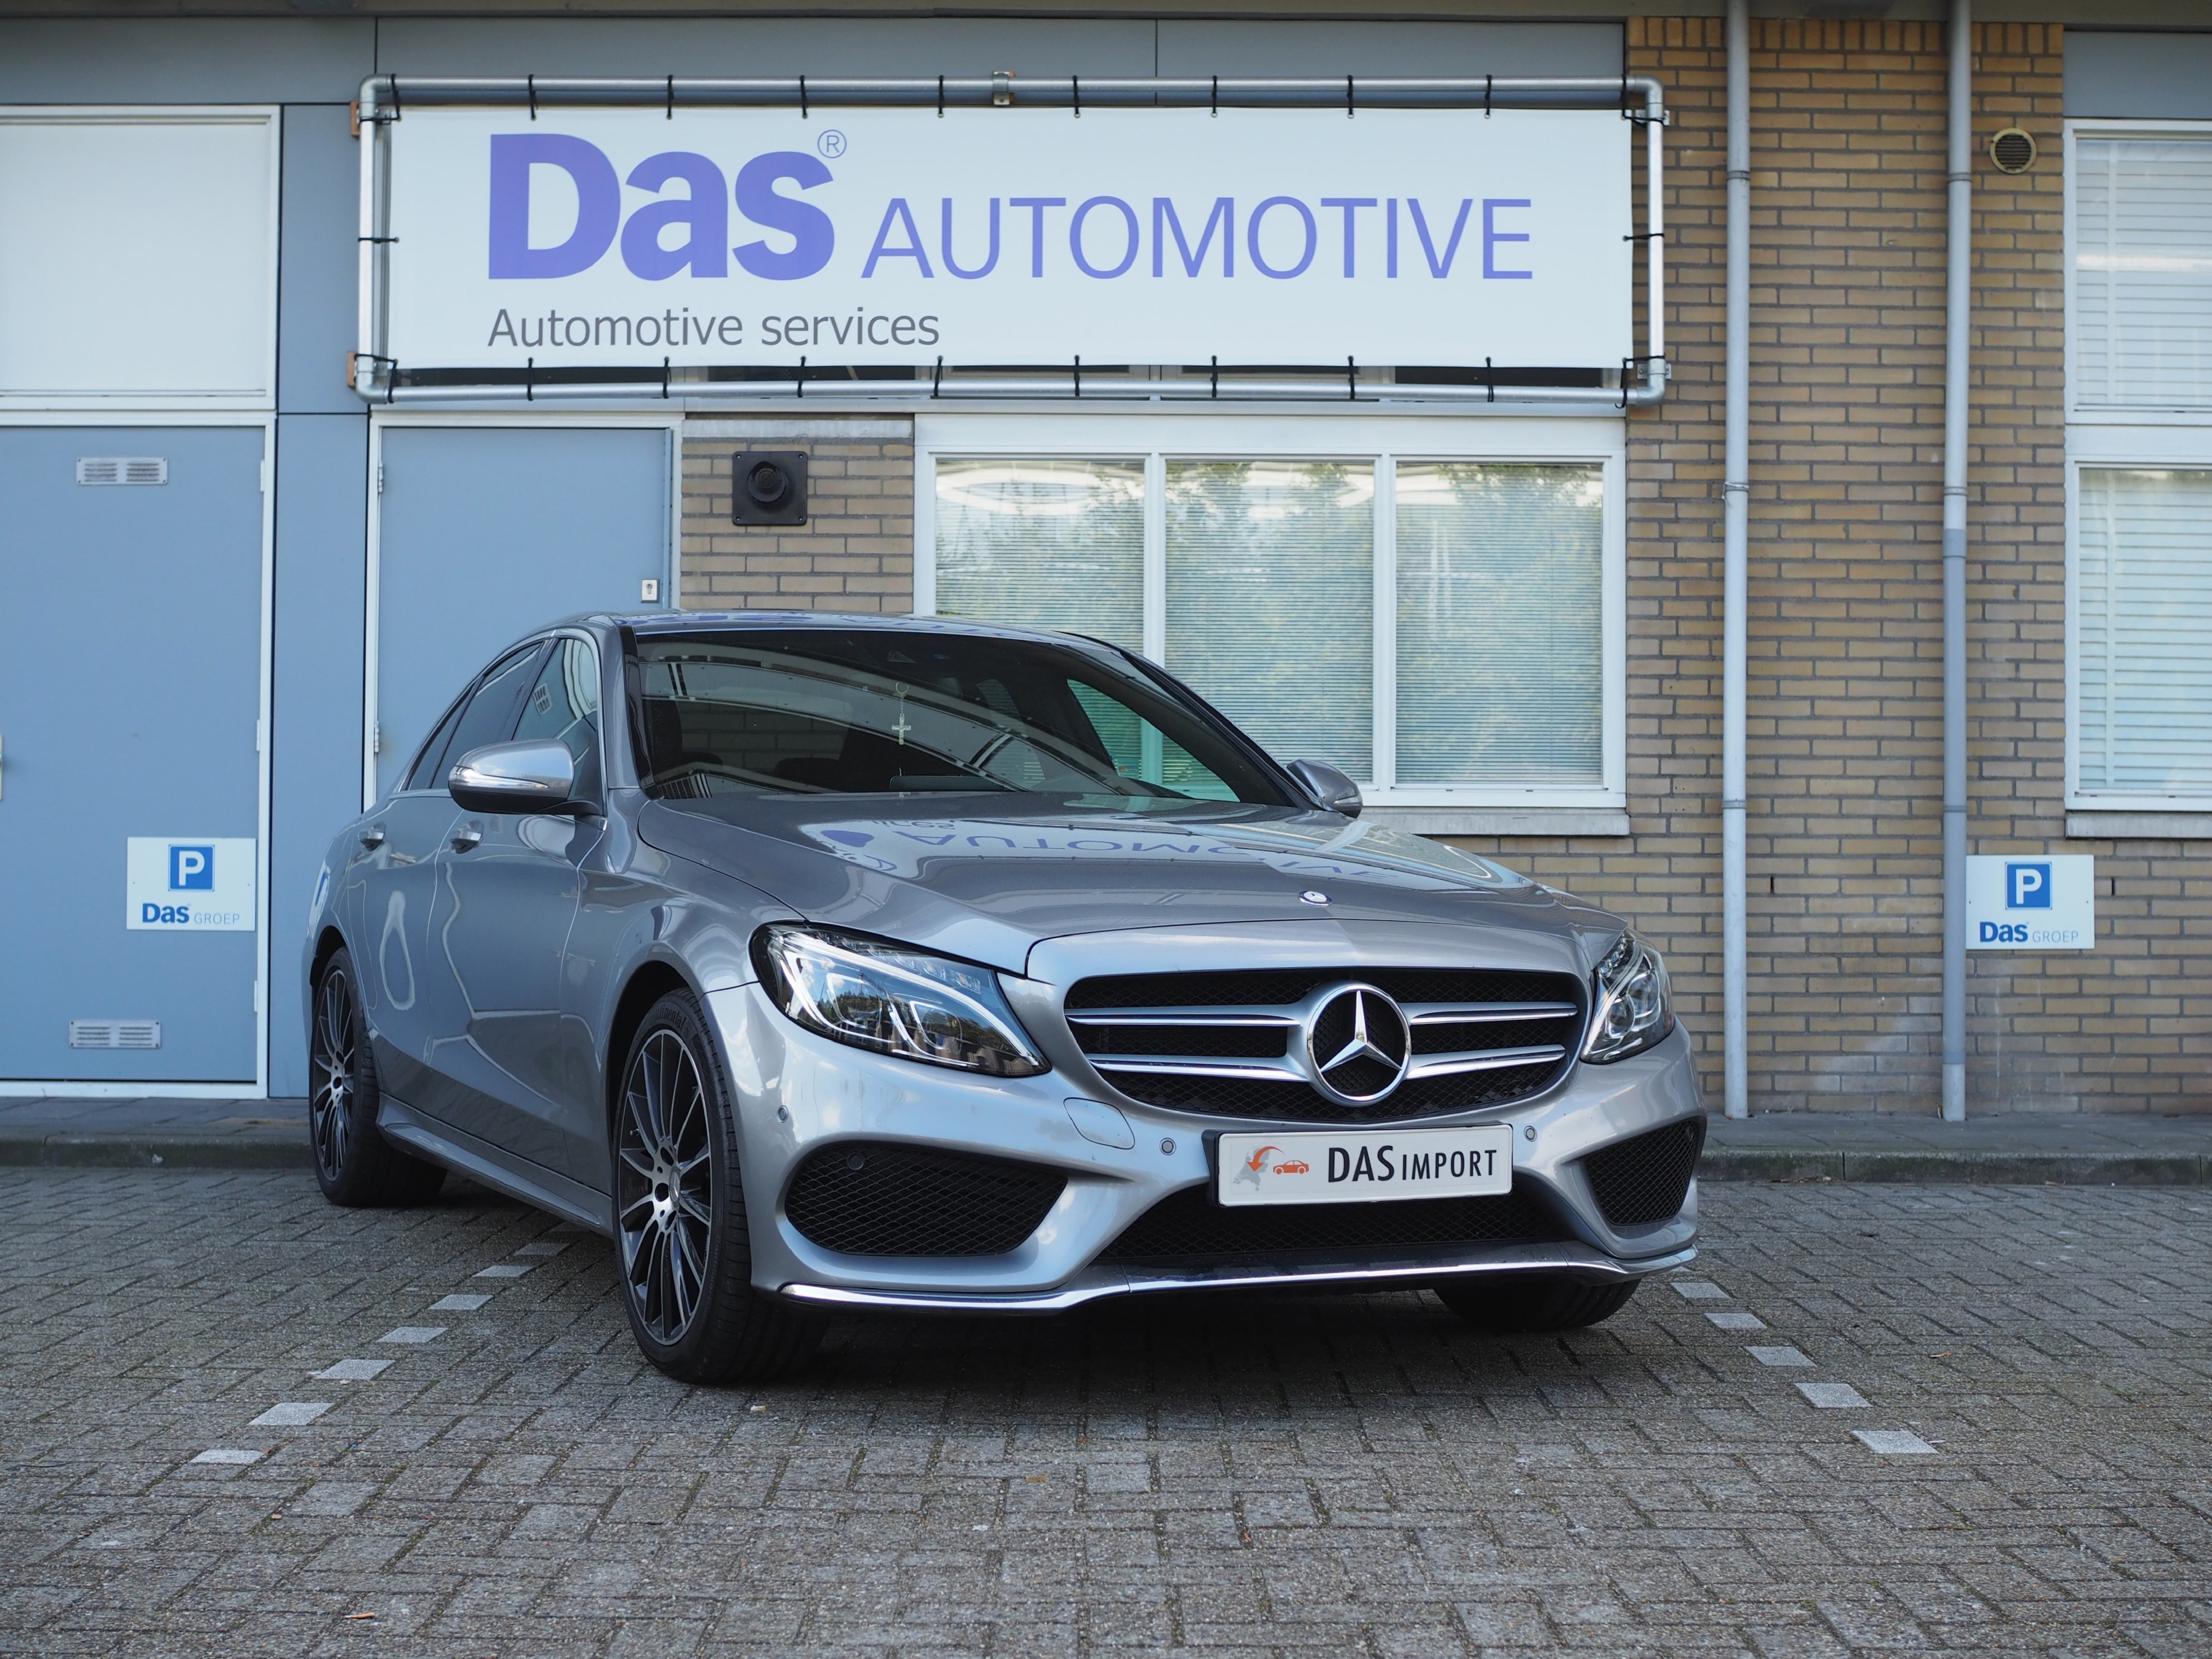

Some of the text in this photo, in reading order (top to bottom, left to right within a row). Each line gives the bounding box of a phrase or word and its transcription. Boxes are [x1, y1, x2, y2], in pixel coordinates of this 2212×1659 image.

[488, 133, 835, 280] Das
[861, 196, 1532, 279] AUTOMOTIVE
[488, 307, 939, 347] Automotive services
[179, 850, 205, 886] P
[2016, 868, 2042, 904] P
[142, 903, 240, 925] Das GROEP
[1979, 921, 2079, 943] Das GROEP
[1328, 1145, 1497, 1183] DAS IMPORT
